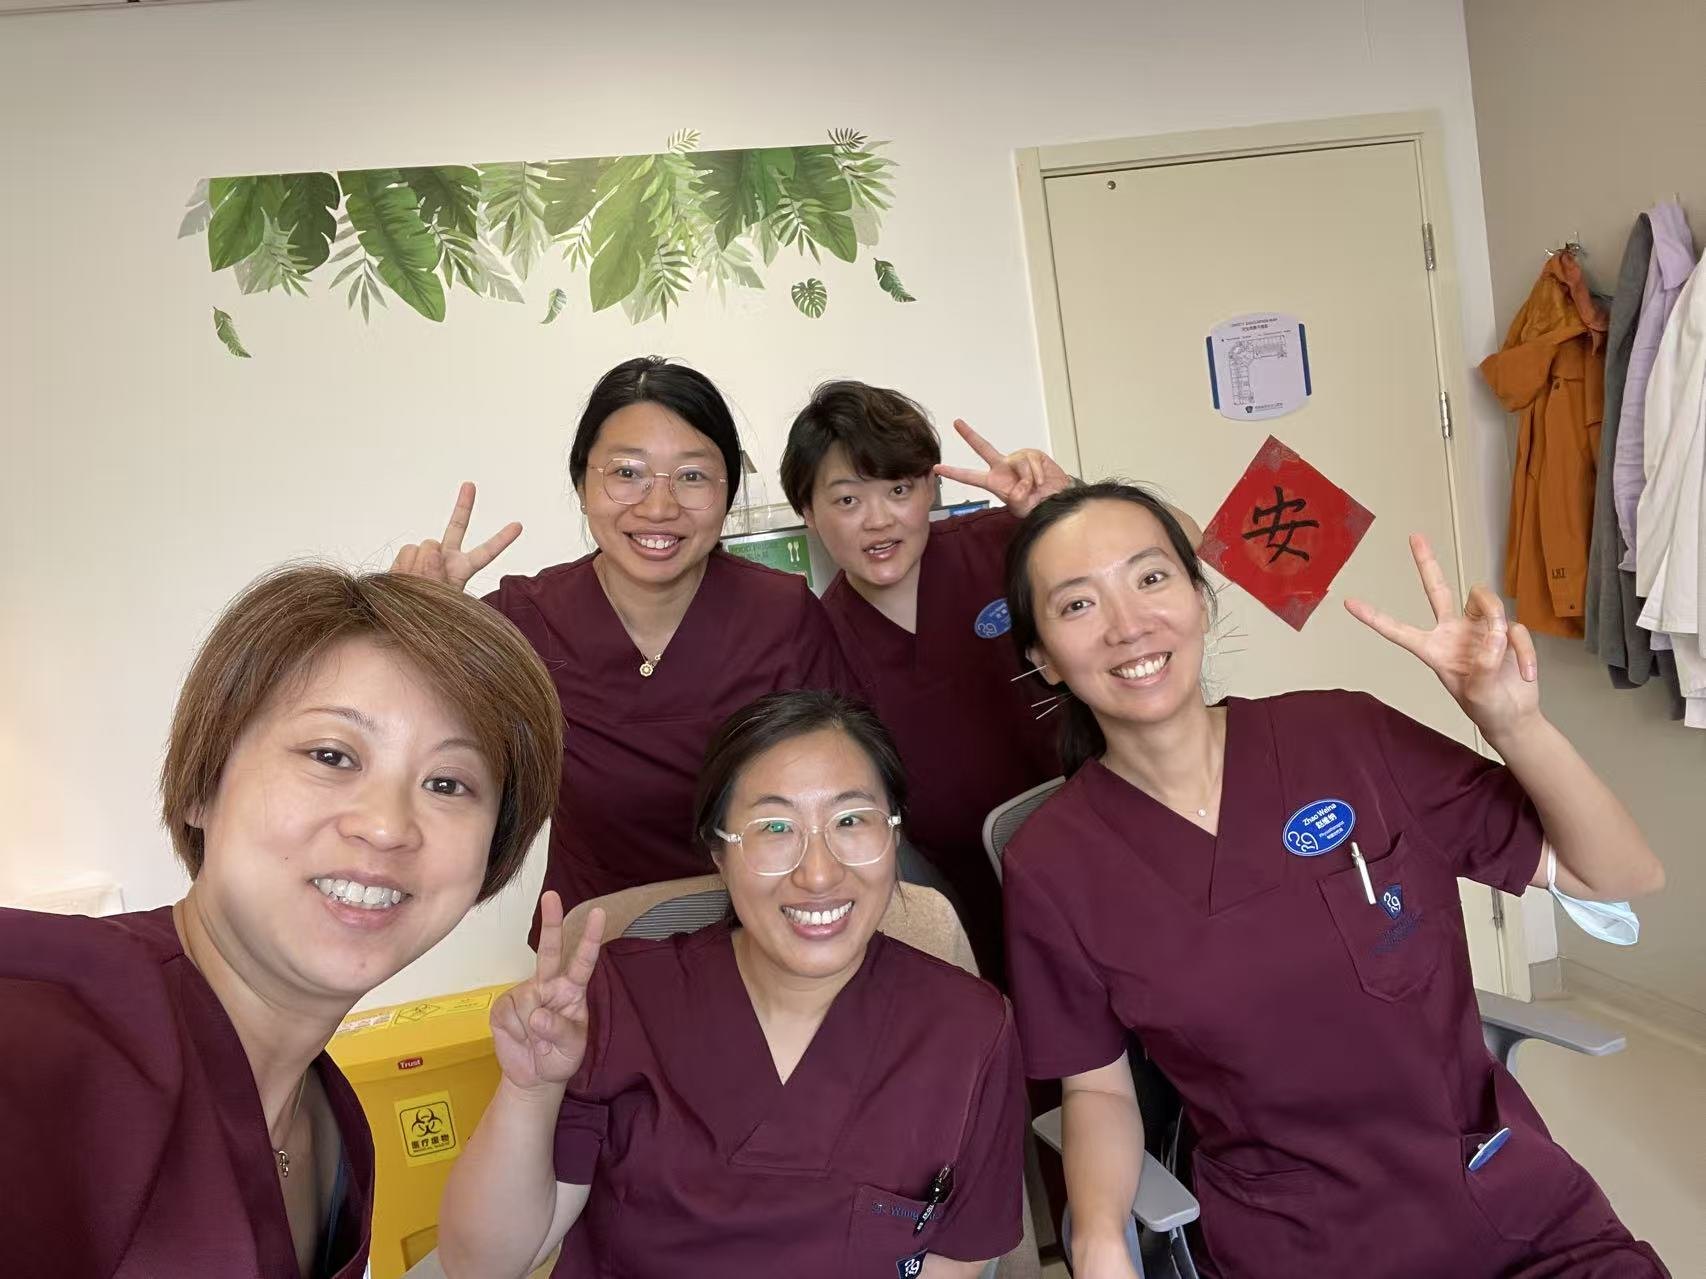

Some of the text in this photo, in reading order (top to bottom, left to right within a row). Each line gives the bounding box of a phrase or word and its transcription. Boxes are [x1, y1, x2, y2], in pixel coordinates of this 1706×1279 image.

[1242, 486, 1320, 565] 安
[1302, 803, 1337, 827] Zhao Weina
[400, 1059, 421, 1069] Trust
